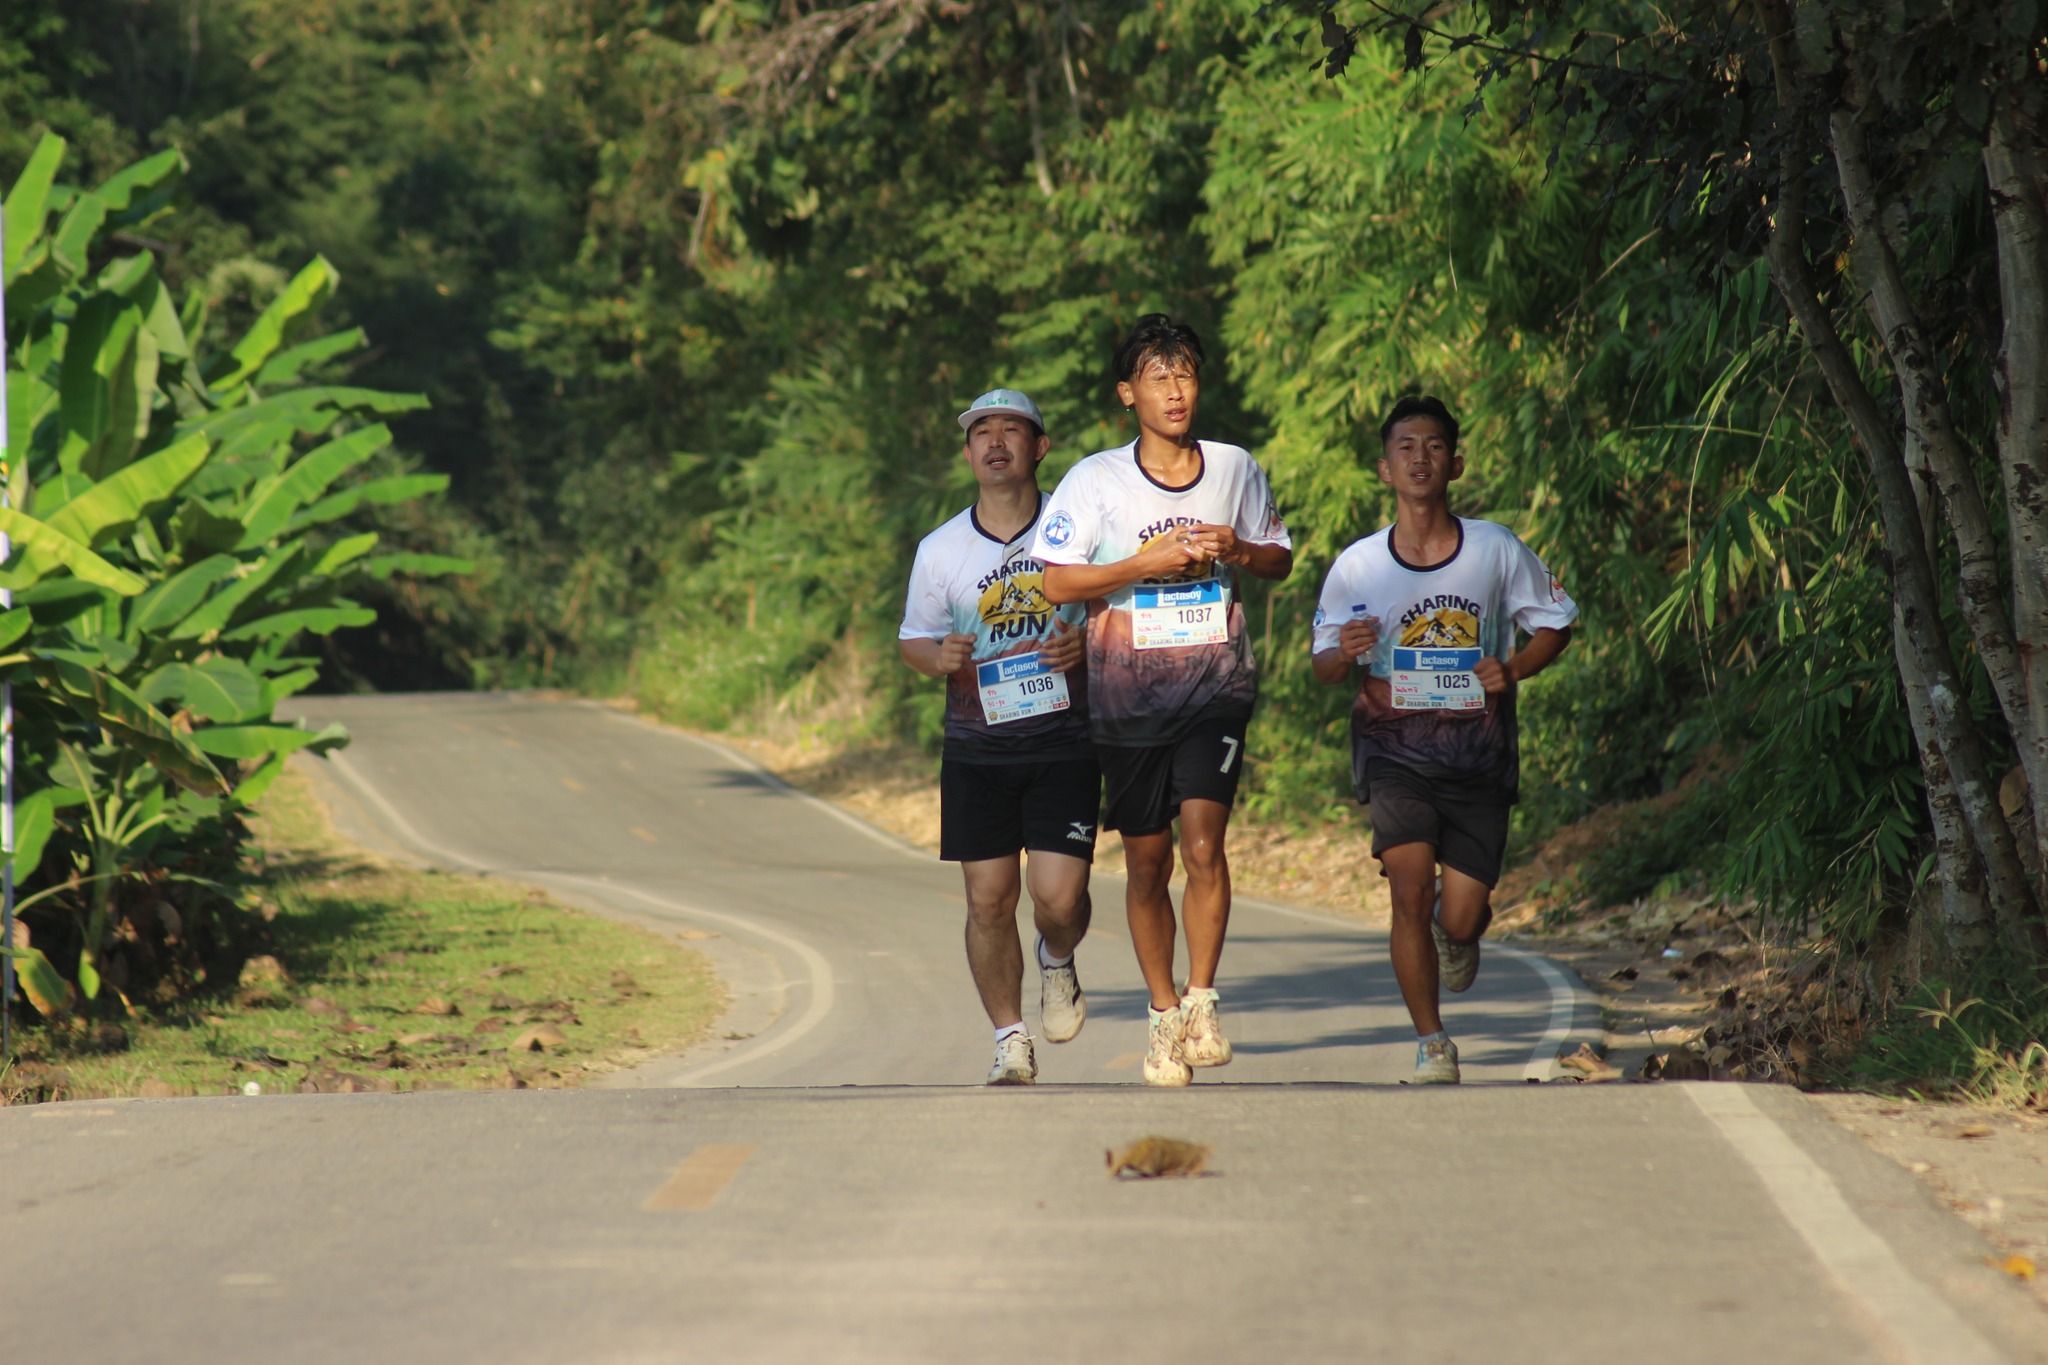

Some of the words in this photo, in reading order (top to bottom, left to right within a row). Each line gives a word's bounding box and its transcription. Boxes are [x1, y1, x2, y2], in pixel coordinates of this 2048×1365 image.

[977, 560, 1044, 594] SHARIN
[1156, 587, 1202, 607] Lactasoy
[1177, 607, 1212, 624] 1037
[1400, 594, 1481, 628] SHARING
[990, 613, 1047, 643] RUN
[996, 660, 1039, 682] Lactasoy
[1414, 651, 1459, 670] Lactasoy
[1019, 676, 1054, 696] 1036
[1434, 674, 1470, 689] 1025
[1220, 735, 1239, 774] 7
